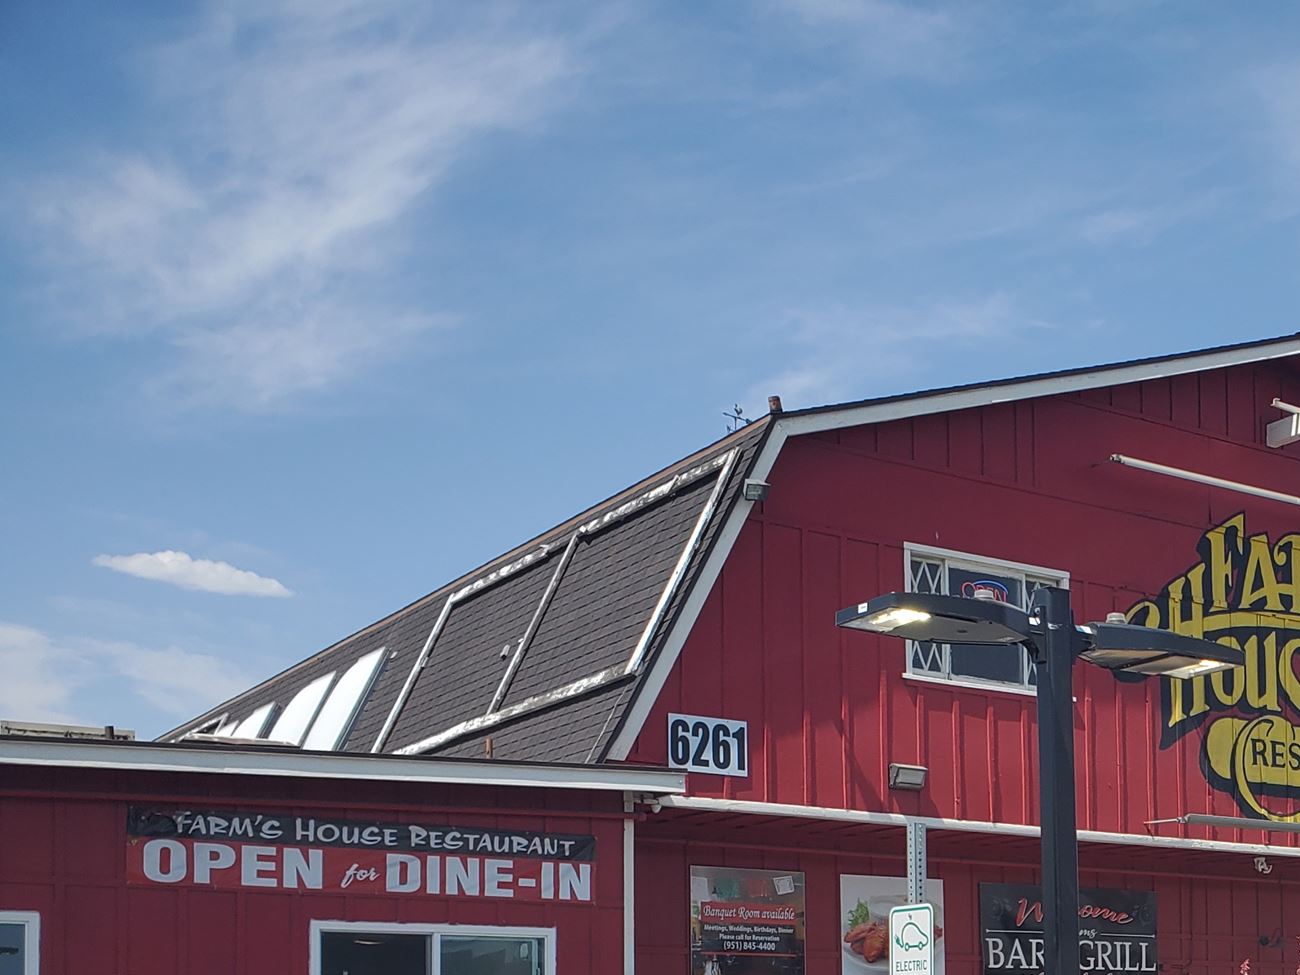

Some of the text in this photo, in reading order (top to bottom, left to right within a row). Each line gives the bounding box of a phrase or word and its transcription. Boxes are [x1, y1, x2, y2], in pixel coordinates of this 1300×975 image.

[670, 719, 746, 770] 6261
[174, 811, 575, 857] FARM'S HOUSE RESTAURANT
[142, 838, 591, 901] OPEN for DINE-IN
[703, 905, 795, 920] Banquet Room available
[704, 924, 729, 932] Meetings,
[729, 925, 754, 934] Weddings,
[754, 926, 778, 934] Birthdays,
[723, 940, 776, 952] (951) 845-4400
[1079, 939, 1157, 972] GRILL
[895, 959, 928, 972] ELECTRIC
